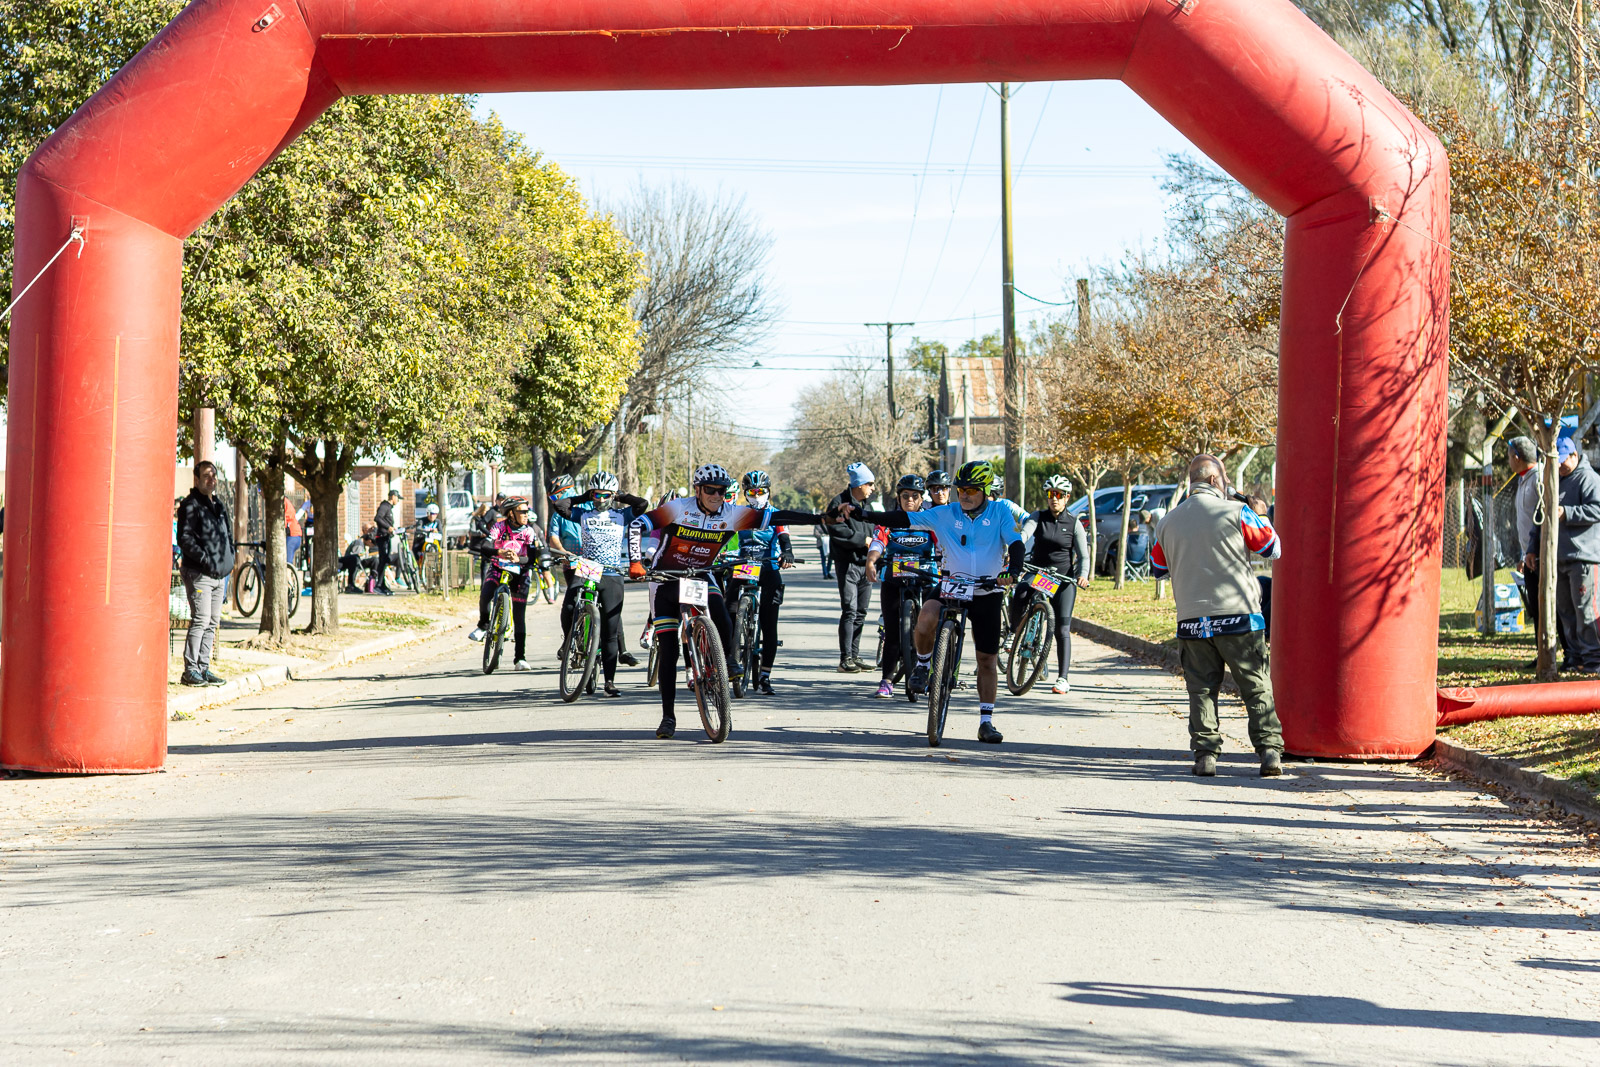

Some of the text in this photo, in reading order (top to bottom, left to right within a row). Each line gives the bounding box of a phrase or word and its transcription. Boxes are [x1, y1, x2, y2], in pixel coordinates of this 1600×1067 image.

[684, 585, 704, 600] 85
[948, 582, 969, 595] 75
[1180, 616, 1241, 629] PROTECH
